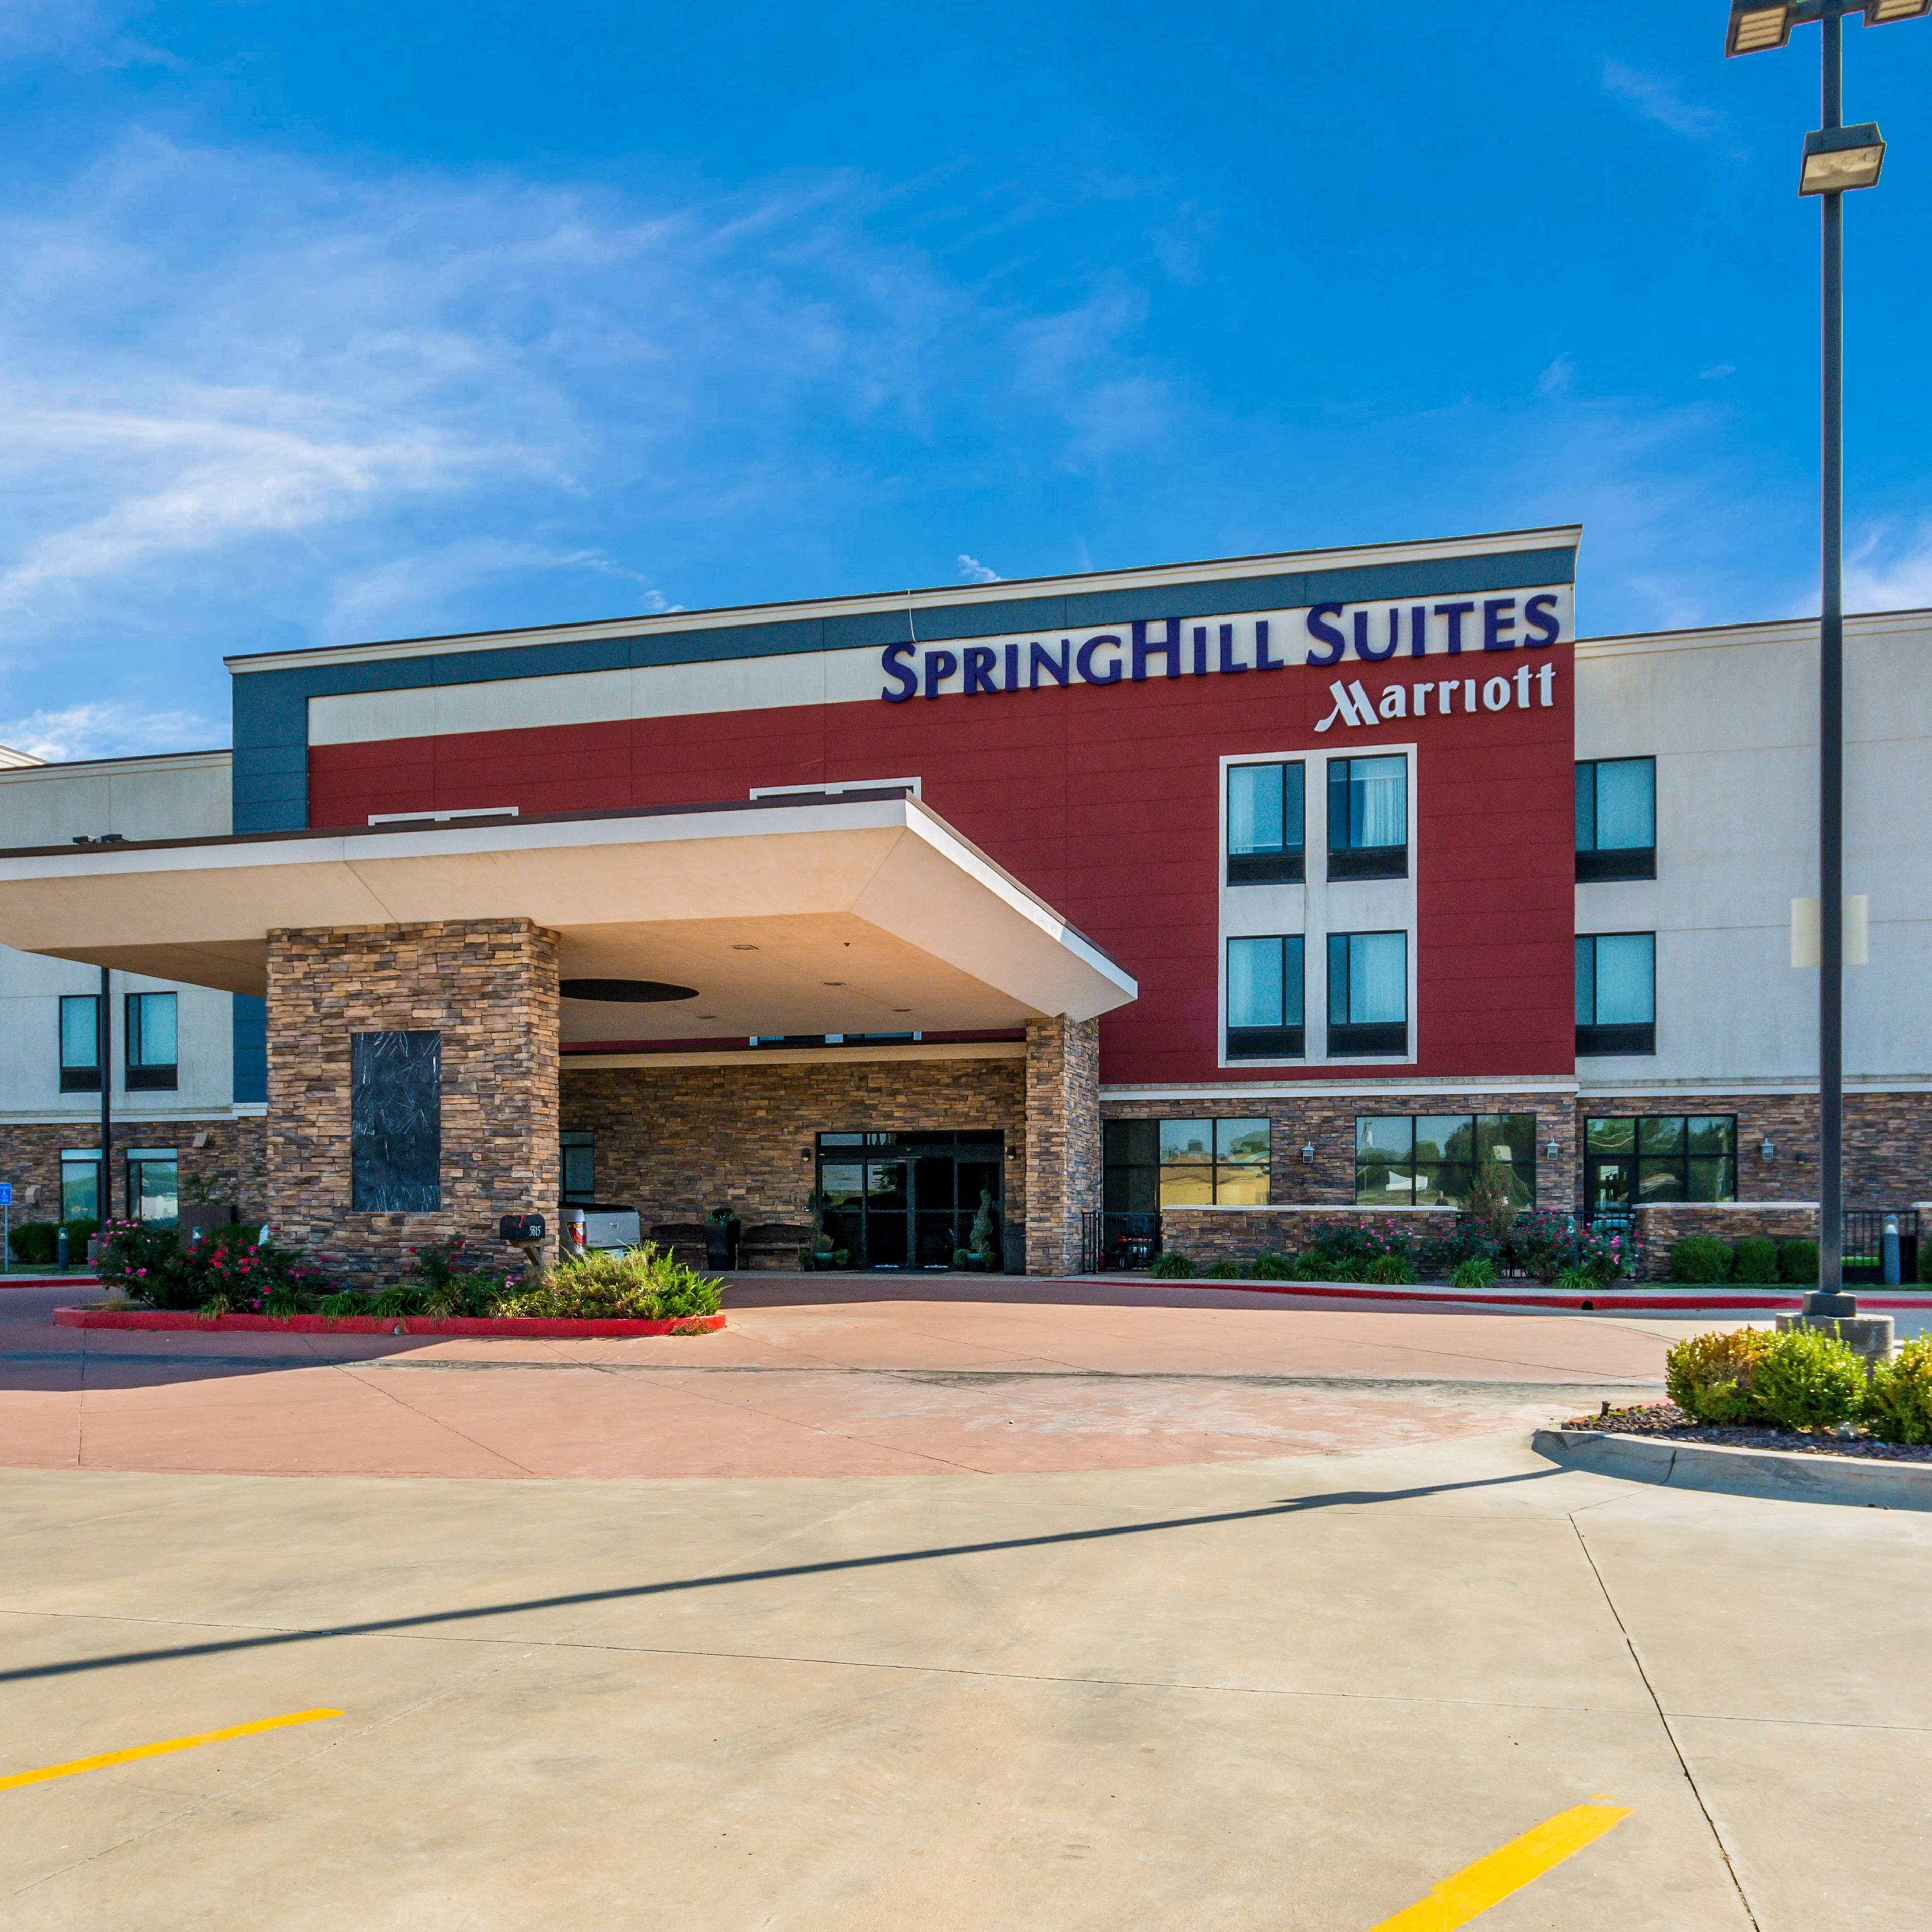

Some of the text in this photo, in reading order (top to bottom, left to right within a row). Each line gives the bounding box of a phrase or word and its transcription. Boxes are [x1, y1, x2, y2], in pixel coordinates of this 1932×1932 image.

[881, 594, 1560, 702] SPRINGHILL SUITES
[1314, 662, 1556, 732] Marriott
[530, 1225, 541, 1236] 5815
